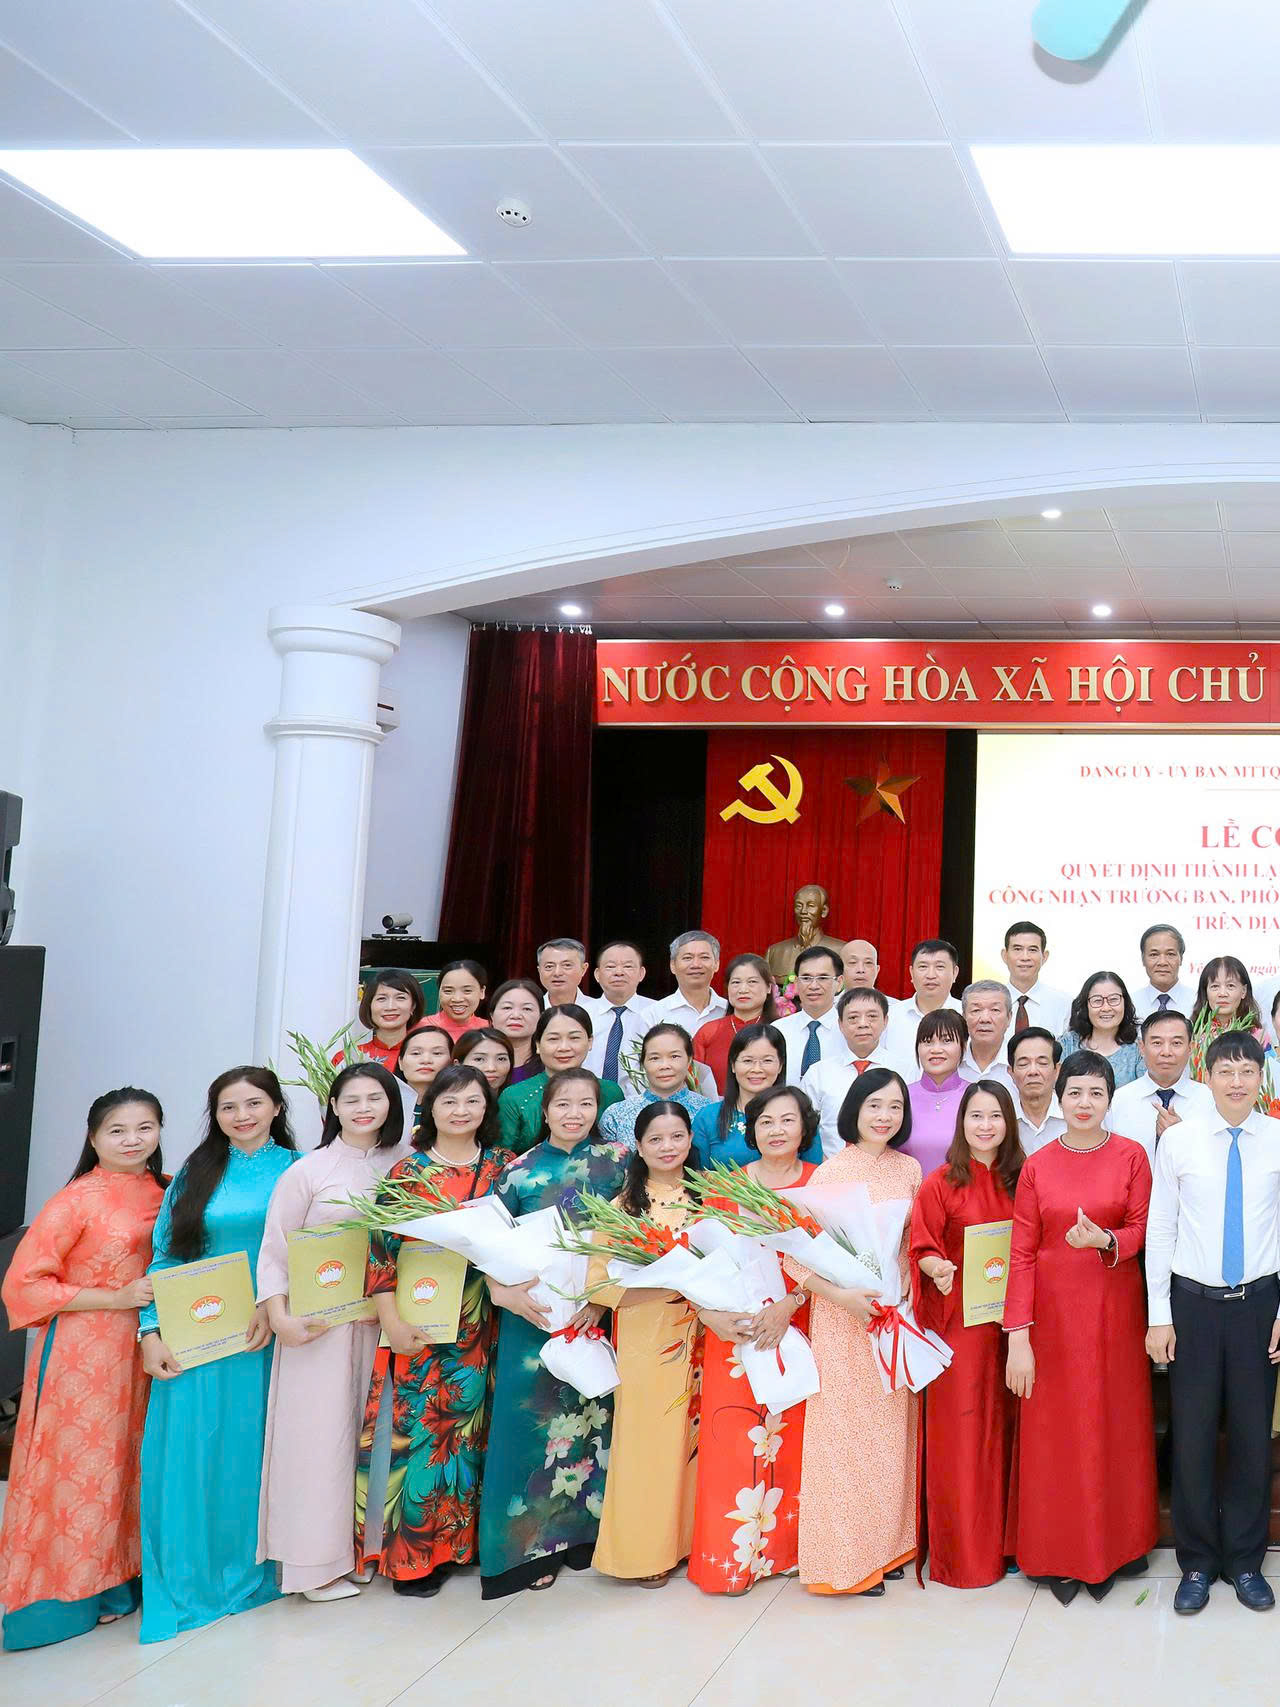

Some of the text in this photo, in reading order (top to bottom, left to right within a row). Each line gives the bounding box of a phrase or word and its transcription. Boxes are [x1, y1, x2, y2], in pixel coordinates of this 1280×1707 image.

[601, 652, 731, 703] NƯỚC
[741, 655, 869, 712] CỘNG
[882, 652, 980, 702] HÒA
[992, 656, 1055, 702] XÃ
[1068, 654, 1154, 713] HỘI
[1168, 652, 1267, 703] CHỦ
[1195, 766, 1228, 778] BAN
[1233, 766, 1280, 780] MTTQ
[988, 884, 1044, 904] CÔNG
[1193, 911, 1242, 929] TRÊN
